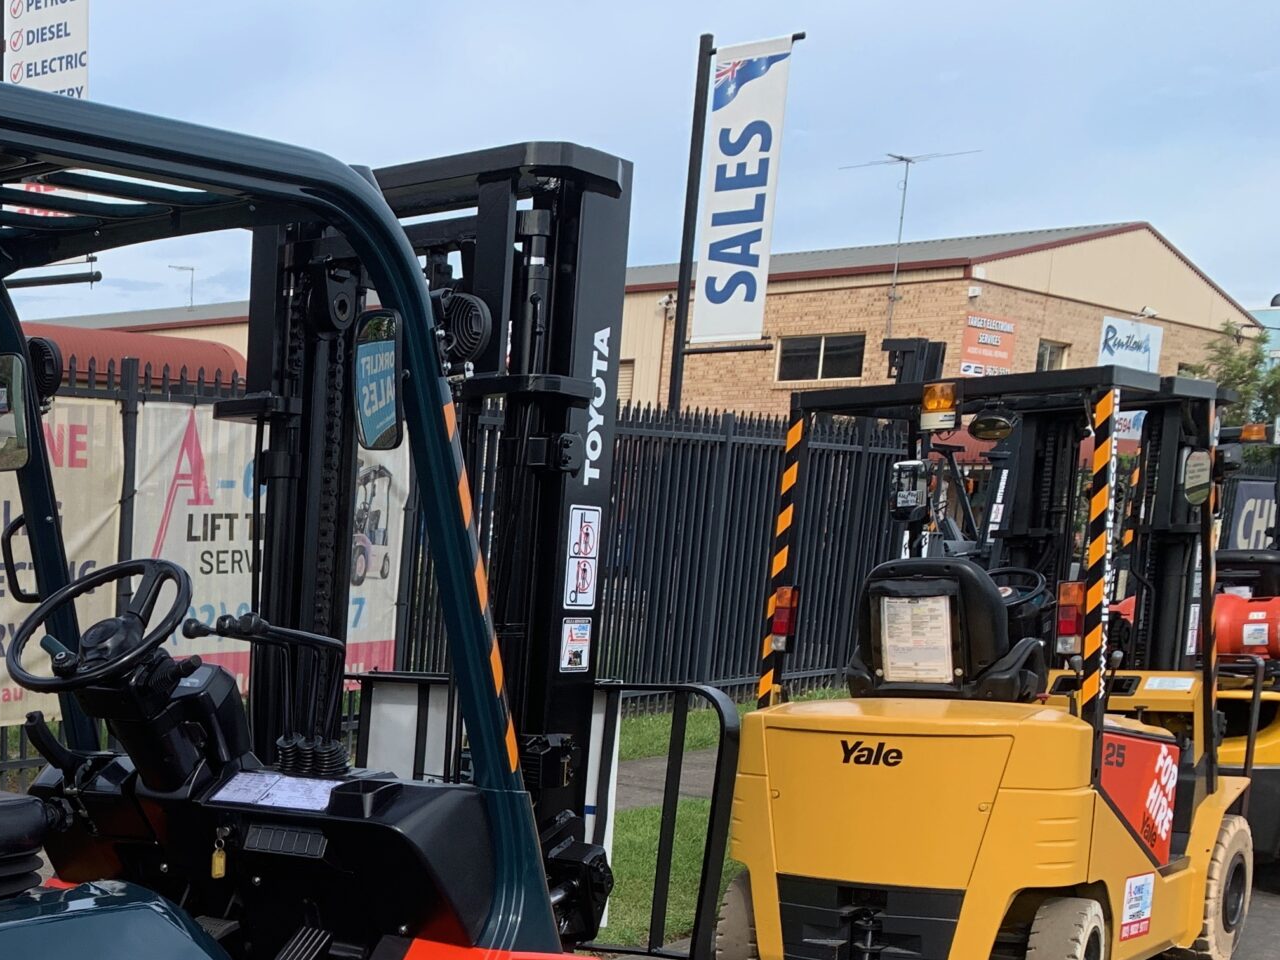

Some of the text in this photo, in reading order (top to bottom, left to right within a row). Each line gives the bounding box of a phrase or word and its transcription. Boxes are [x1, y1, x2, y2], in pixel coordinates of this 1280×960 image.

[26, 22, 71, 46] DIESEL
[26, 51, 87, 78] ELECTRIC
[705, 119, 773, 306] SALES
[583, 327, 612, 486] TOYOTA
[187, 513, 239, 542] LIFT
[840, 740, 903, 767] Yale
[1104, 742, 1126, 768] 25
[1155, 743, 1178, 801] FOR
[1145, 778, 1174, 841] HIRE
